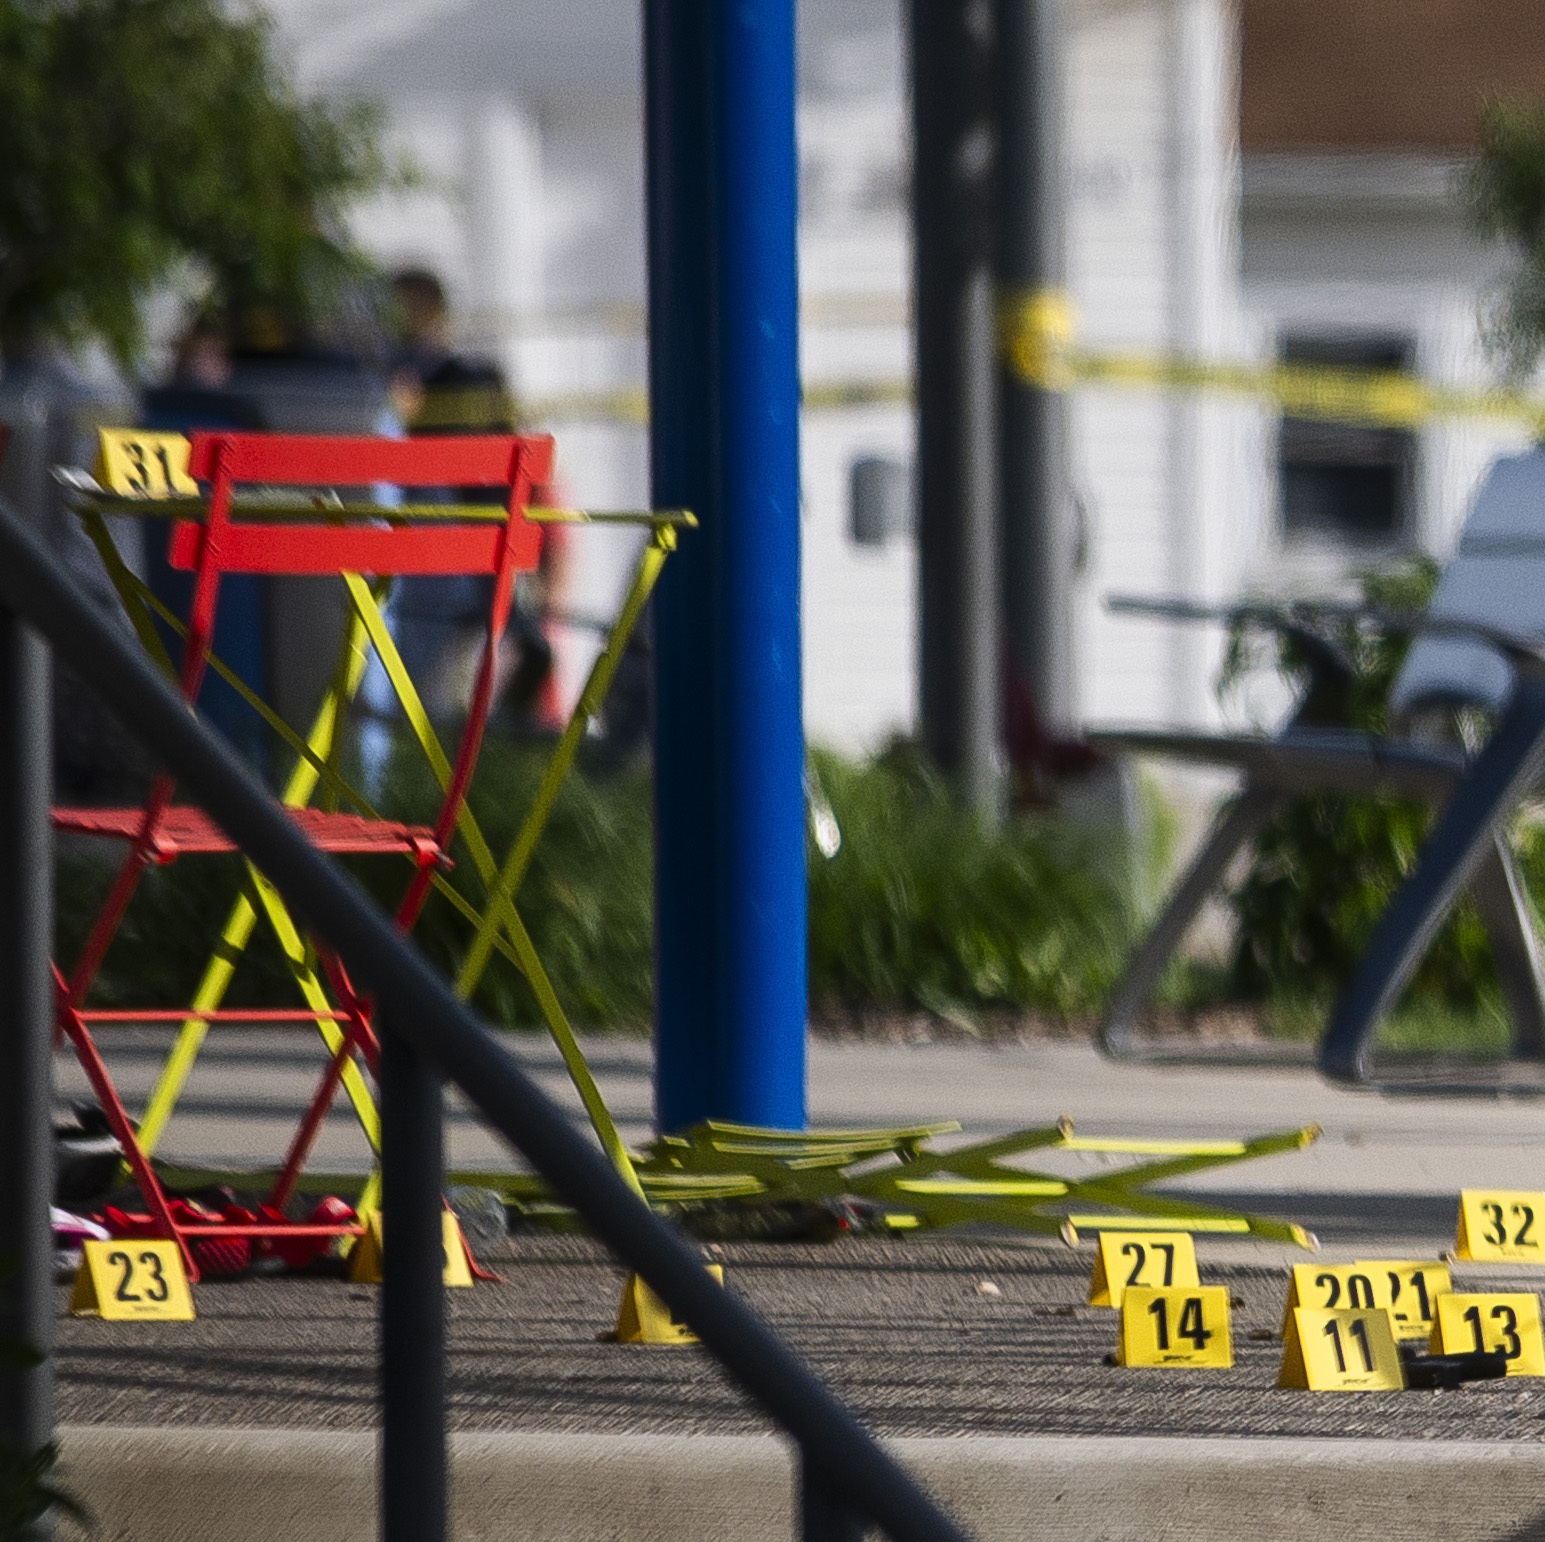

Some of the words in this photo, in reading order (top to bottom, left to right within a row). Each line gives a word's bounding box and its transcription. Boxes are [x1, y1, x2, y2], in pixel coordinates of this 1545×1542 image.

[122, 442, 178, 497] 31
[1481, 1201, 1540, 1249] 32
[107, 1251, 169, 1303] 23
[1121, 1243, 1175, 1287] 27
[1314, 1273, 1375, 1309] 20
[1148, 1298, 1211, 1350] 14
[1323, 1319, 1378, 1373] 11
[1463, 1305, 1521, 1360] 13
